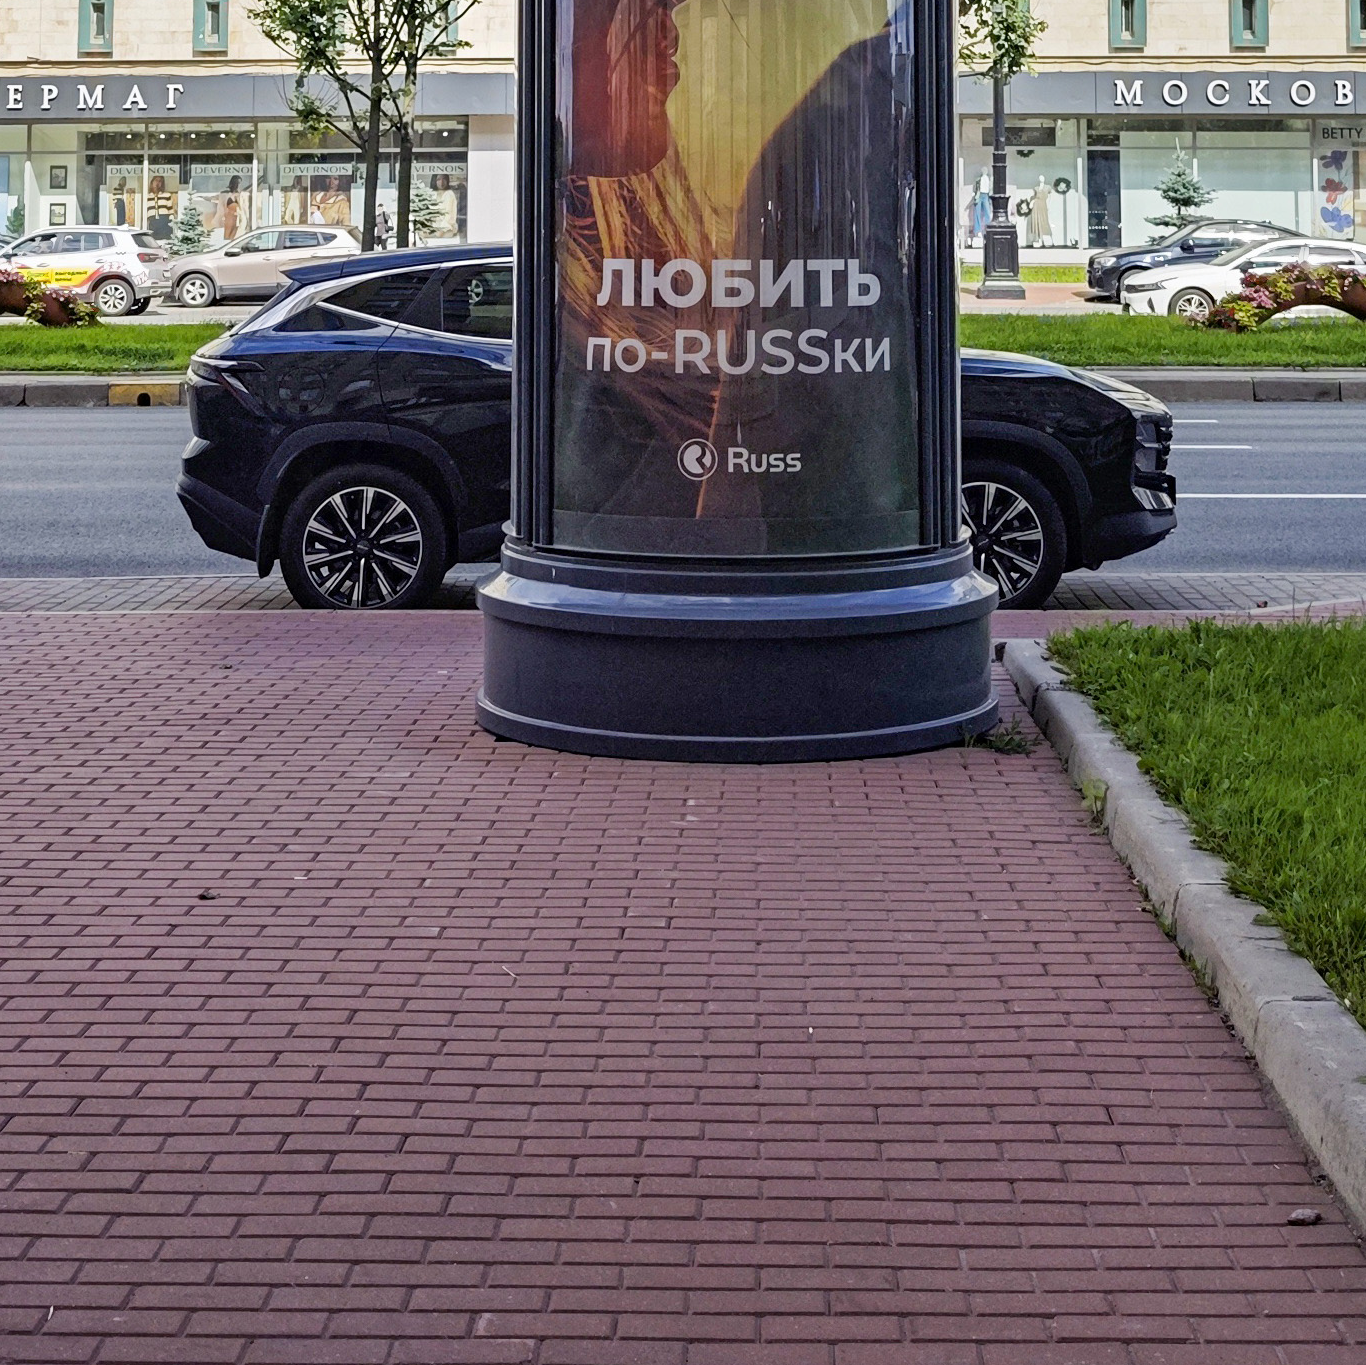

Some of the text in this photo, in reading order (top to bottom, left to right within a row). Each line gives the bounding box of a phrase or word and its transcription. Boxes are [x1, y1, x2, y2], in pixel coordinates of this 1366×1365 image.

[1322, 127, 1363, 139] BETTY
[194, 166, 261, 175] DEVERNOI
[283, 166, 349, 174] DEVERNOIS
[596, 257, 882, 308] ЛЮБИТЬ
[727, 446, 802, 474] Russ
